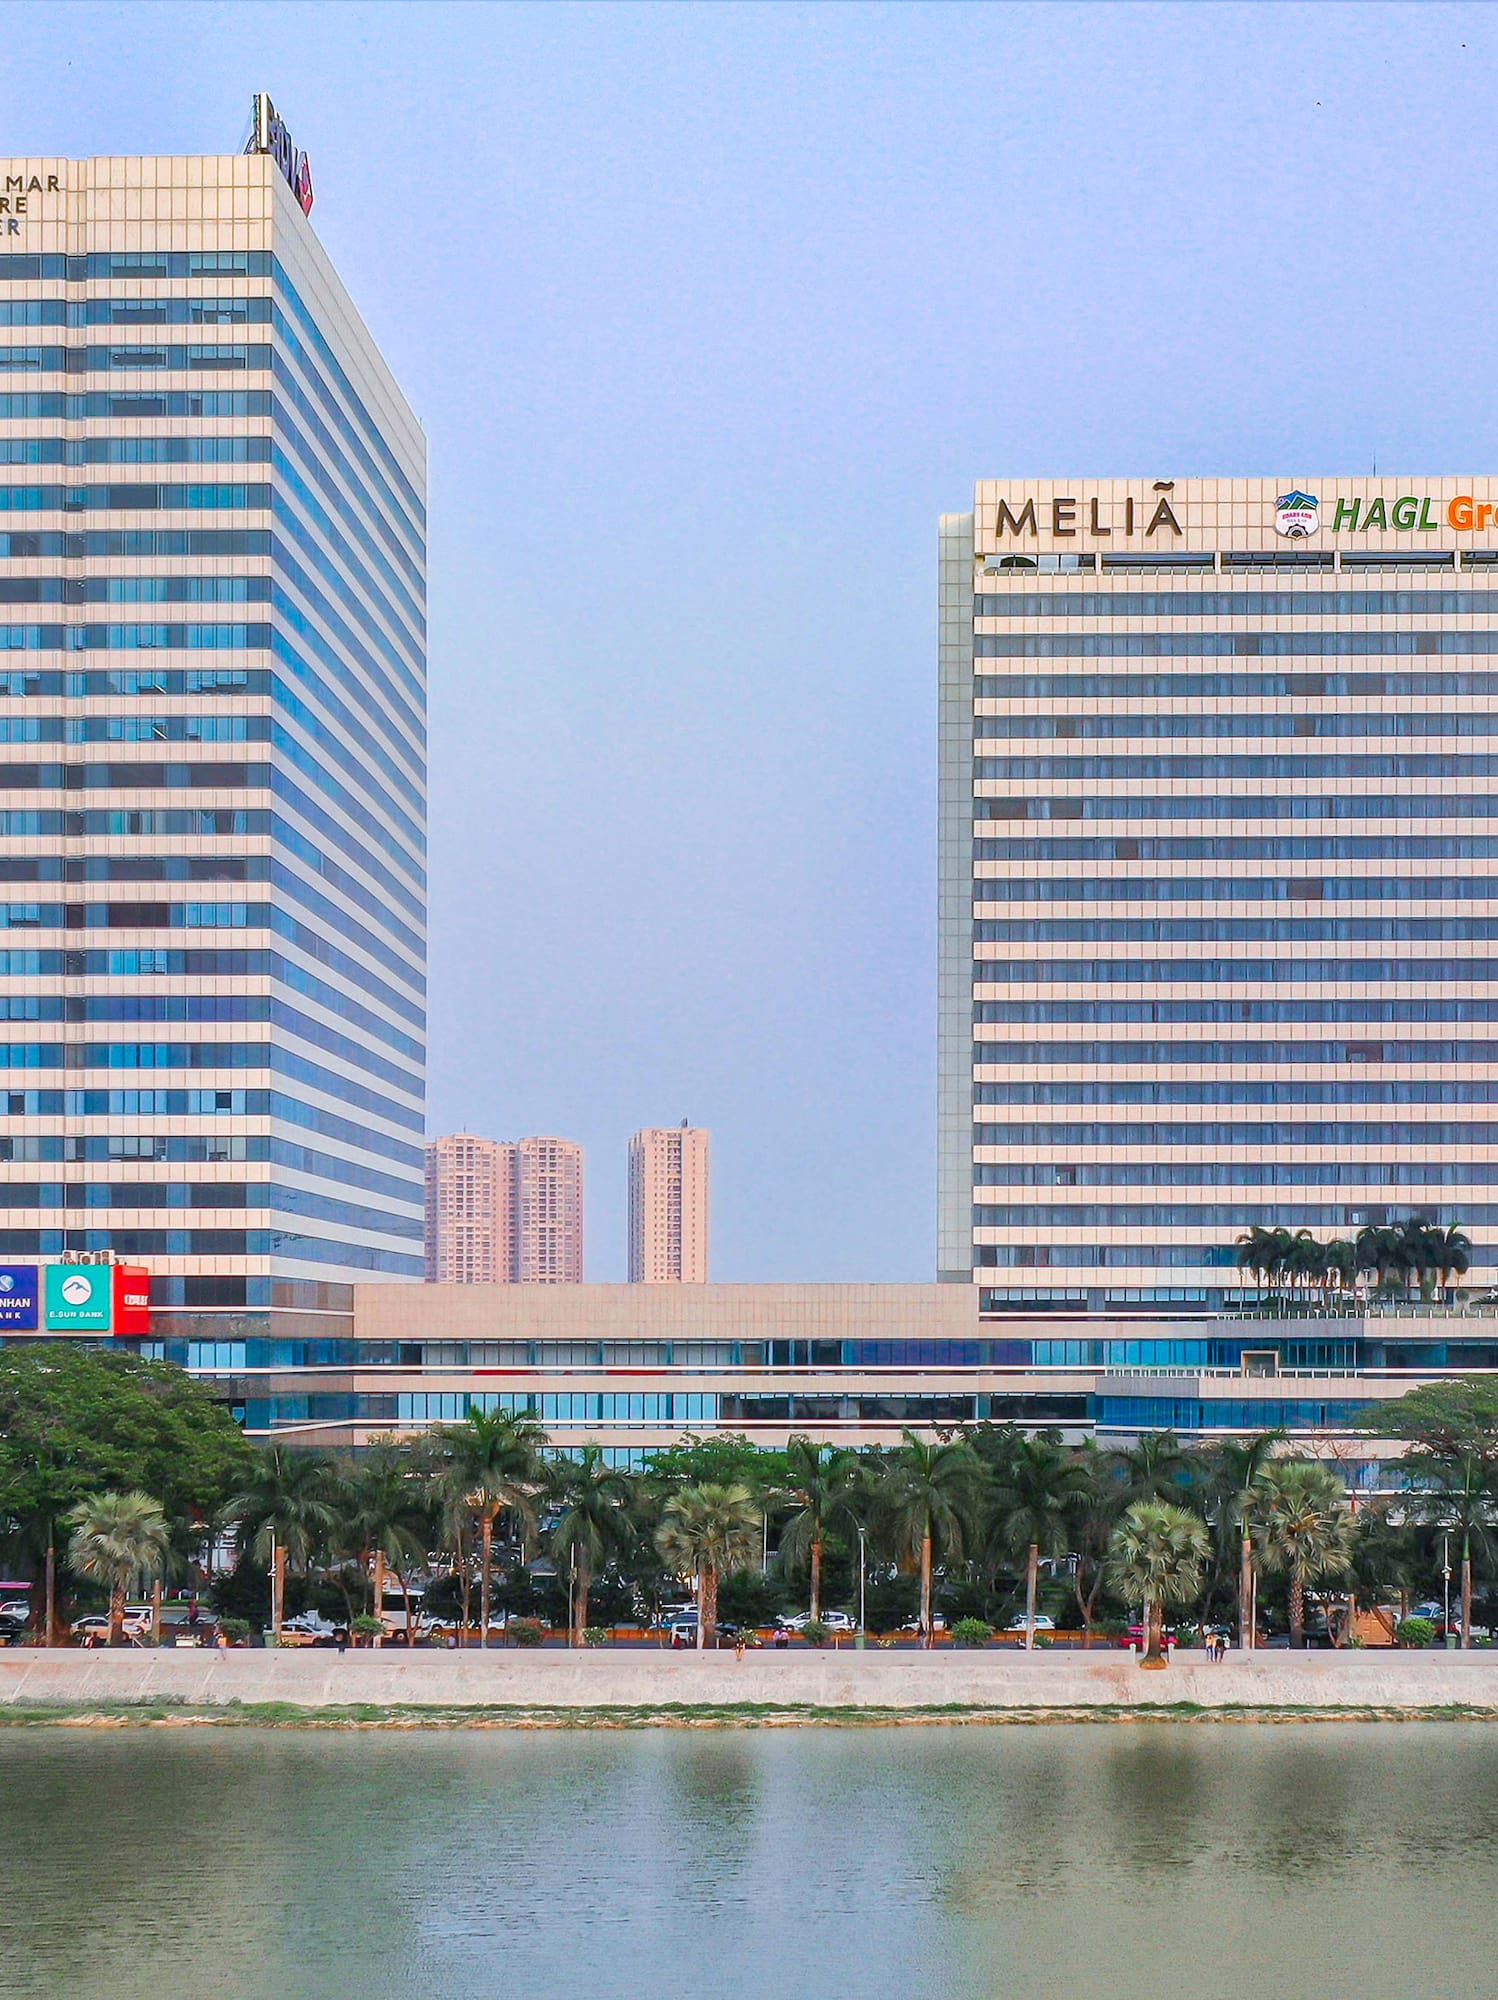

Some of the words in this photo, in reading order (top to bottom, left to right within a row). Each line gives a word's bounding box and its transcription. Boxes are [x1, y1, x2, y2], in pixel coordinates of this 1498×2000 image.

[6, 175, 60, 193] MAR
[0, 197, 27, 214] RE
[1331, 496, 1439, 532] HAGL
[1447, 495, 1498, 532] Gr
